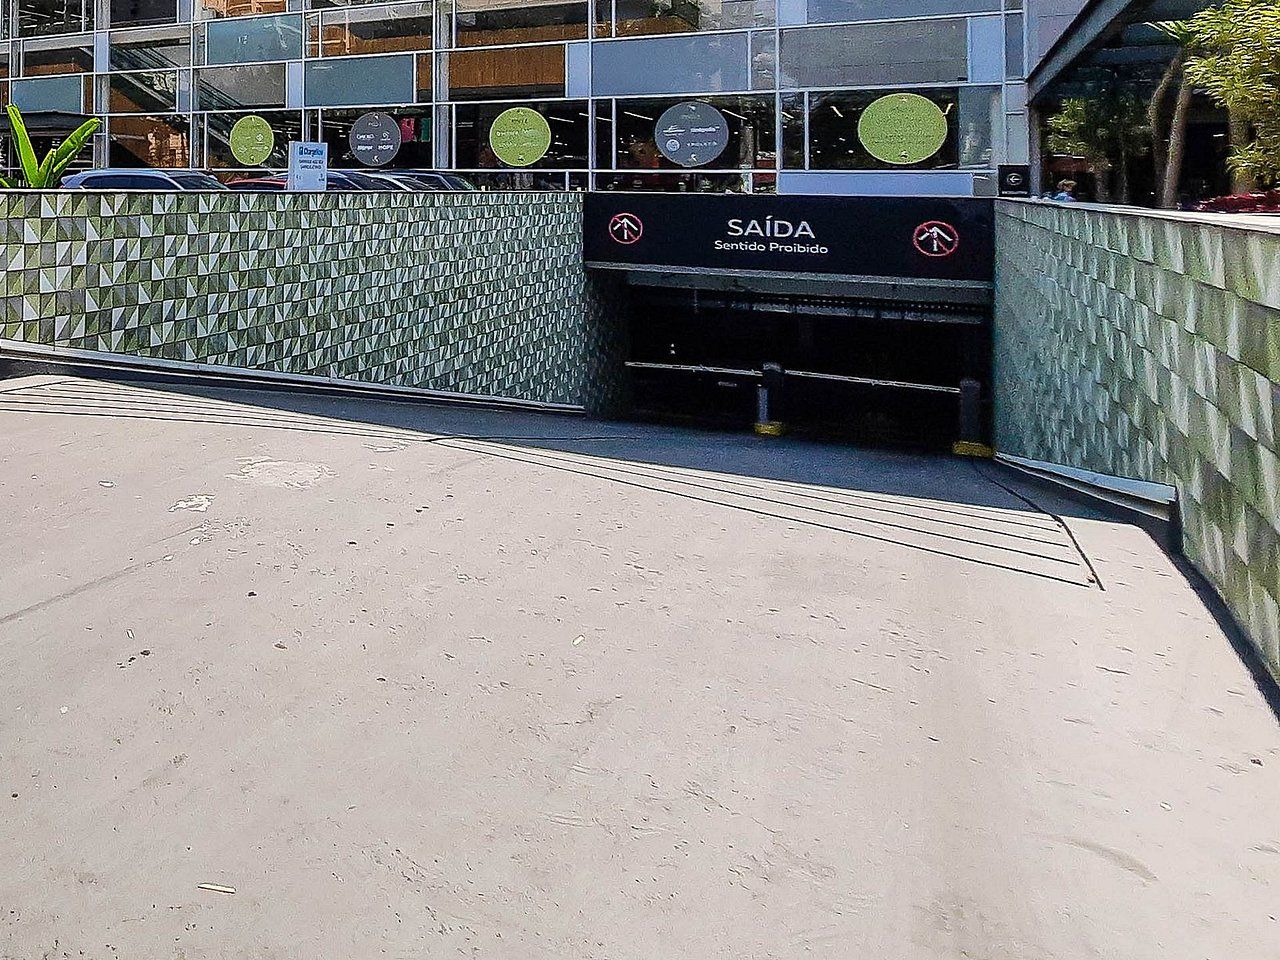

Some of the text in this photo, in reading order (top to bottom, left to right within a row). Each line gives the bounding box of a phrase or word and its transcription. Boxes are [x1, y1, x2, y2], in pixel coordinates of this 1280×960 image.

[727, 215, 816, 239] SAÍDA
[714, 240, 829, 254] Sentido Proibido
